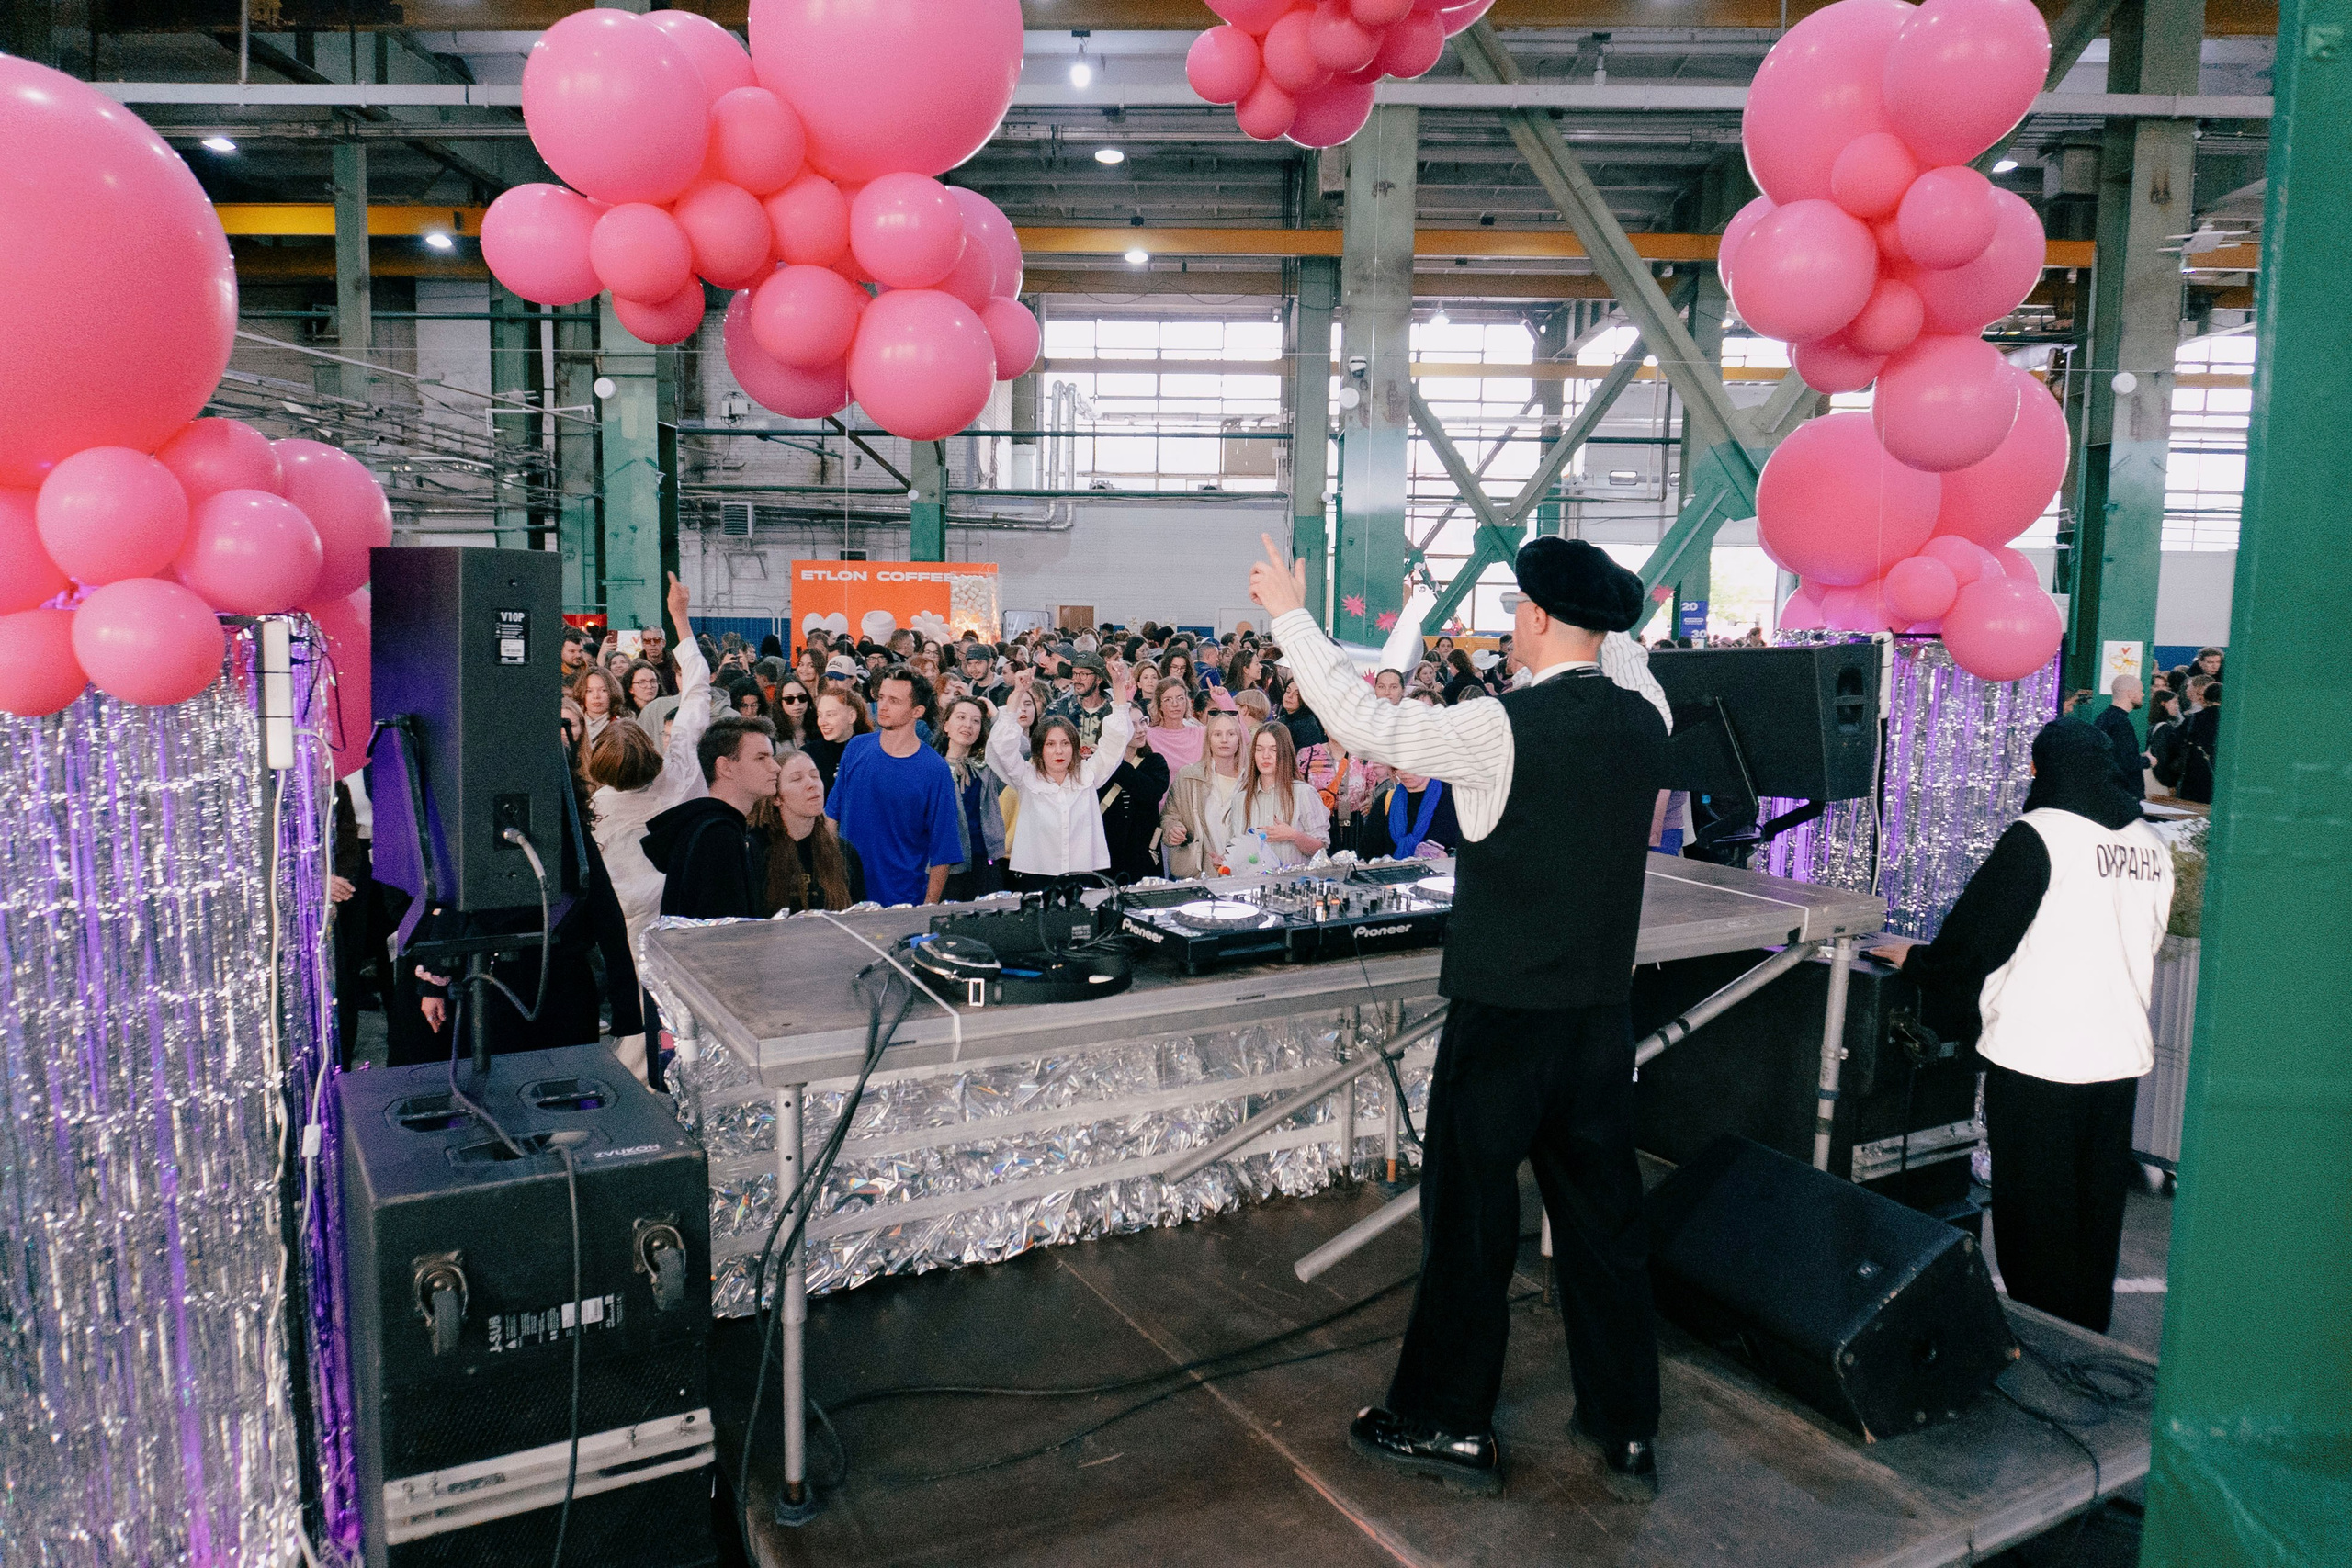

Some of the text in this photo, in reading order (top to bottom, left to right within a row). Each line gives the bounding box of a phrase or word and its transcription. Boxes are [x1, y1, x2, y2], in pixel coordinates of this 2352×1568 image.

[801, 570, 867, 581] ETLON
[1681, 602, 1699, 612] 20
[500, 611, 525, 623] V10P
[1691, 629, 1707, 639] 30
[2097, 844, 2161, 882] ОХРАНА
[1122, 918, 1164, 944] Pioneer
[1353, 924, 1413, 939] Pioneer
[488, 1314, 503, 1353] J-SUB
